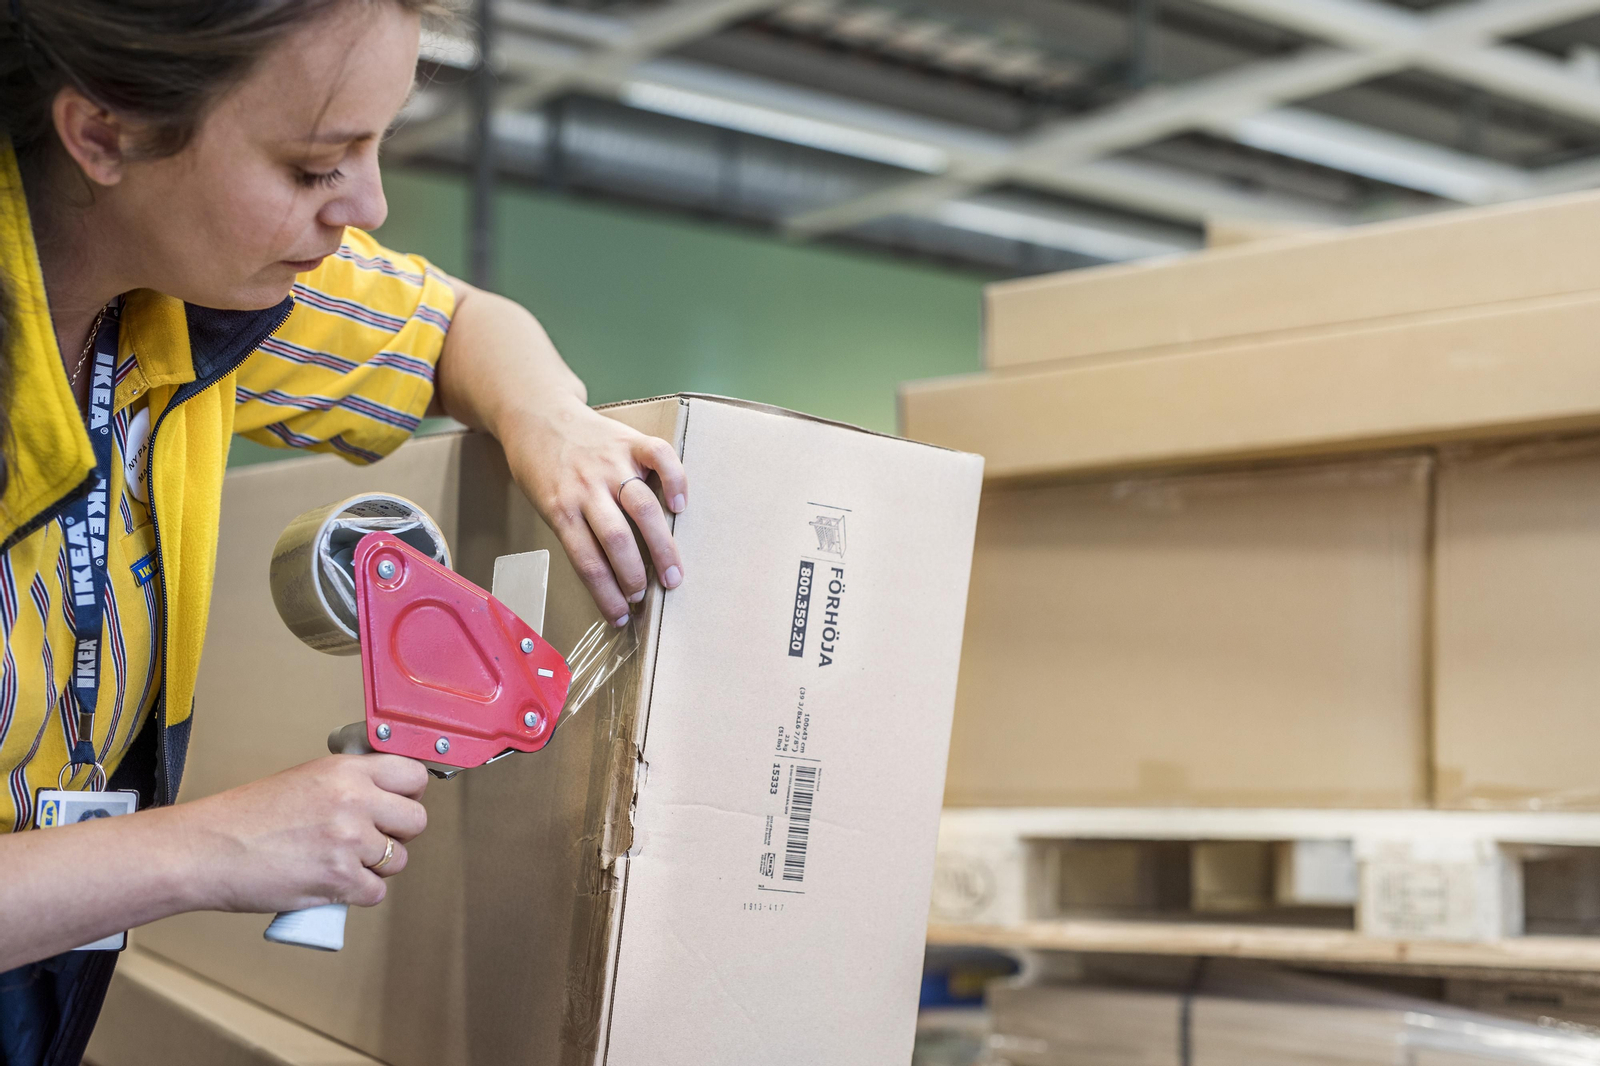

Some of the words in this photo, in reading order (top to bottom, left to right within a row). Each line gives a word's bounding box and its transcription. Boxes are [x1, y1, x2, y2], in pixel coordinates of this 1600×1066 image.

[128, 455, 138, 470] NY
[791, 567, 812, 651] 800.359.20
[818, 567, 845, 667] FÖRHÖJA
[795, 702, 804, 730] 3/8x16
[802, 713, 810, 741] 100x43
[775, 738, 783, 751] lbs)
[782, 743, 789, 751] kg
[784, 734, 790, 742] 23
[800, 742, 806, 753] cm
[770, 763, 780, 795] 15333
